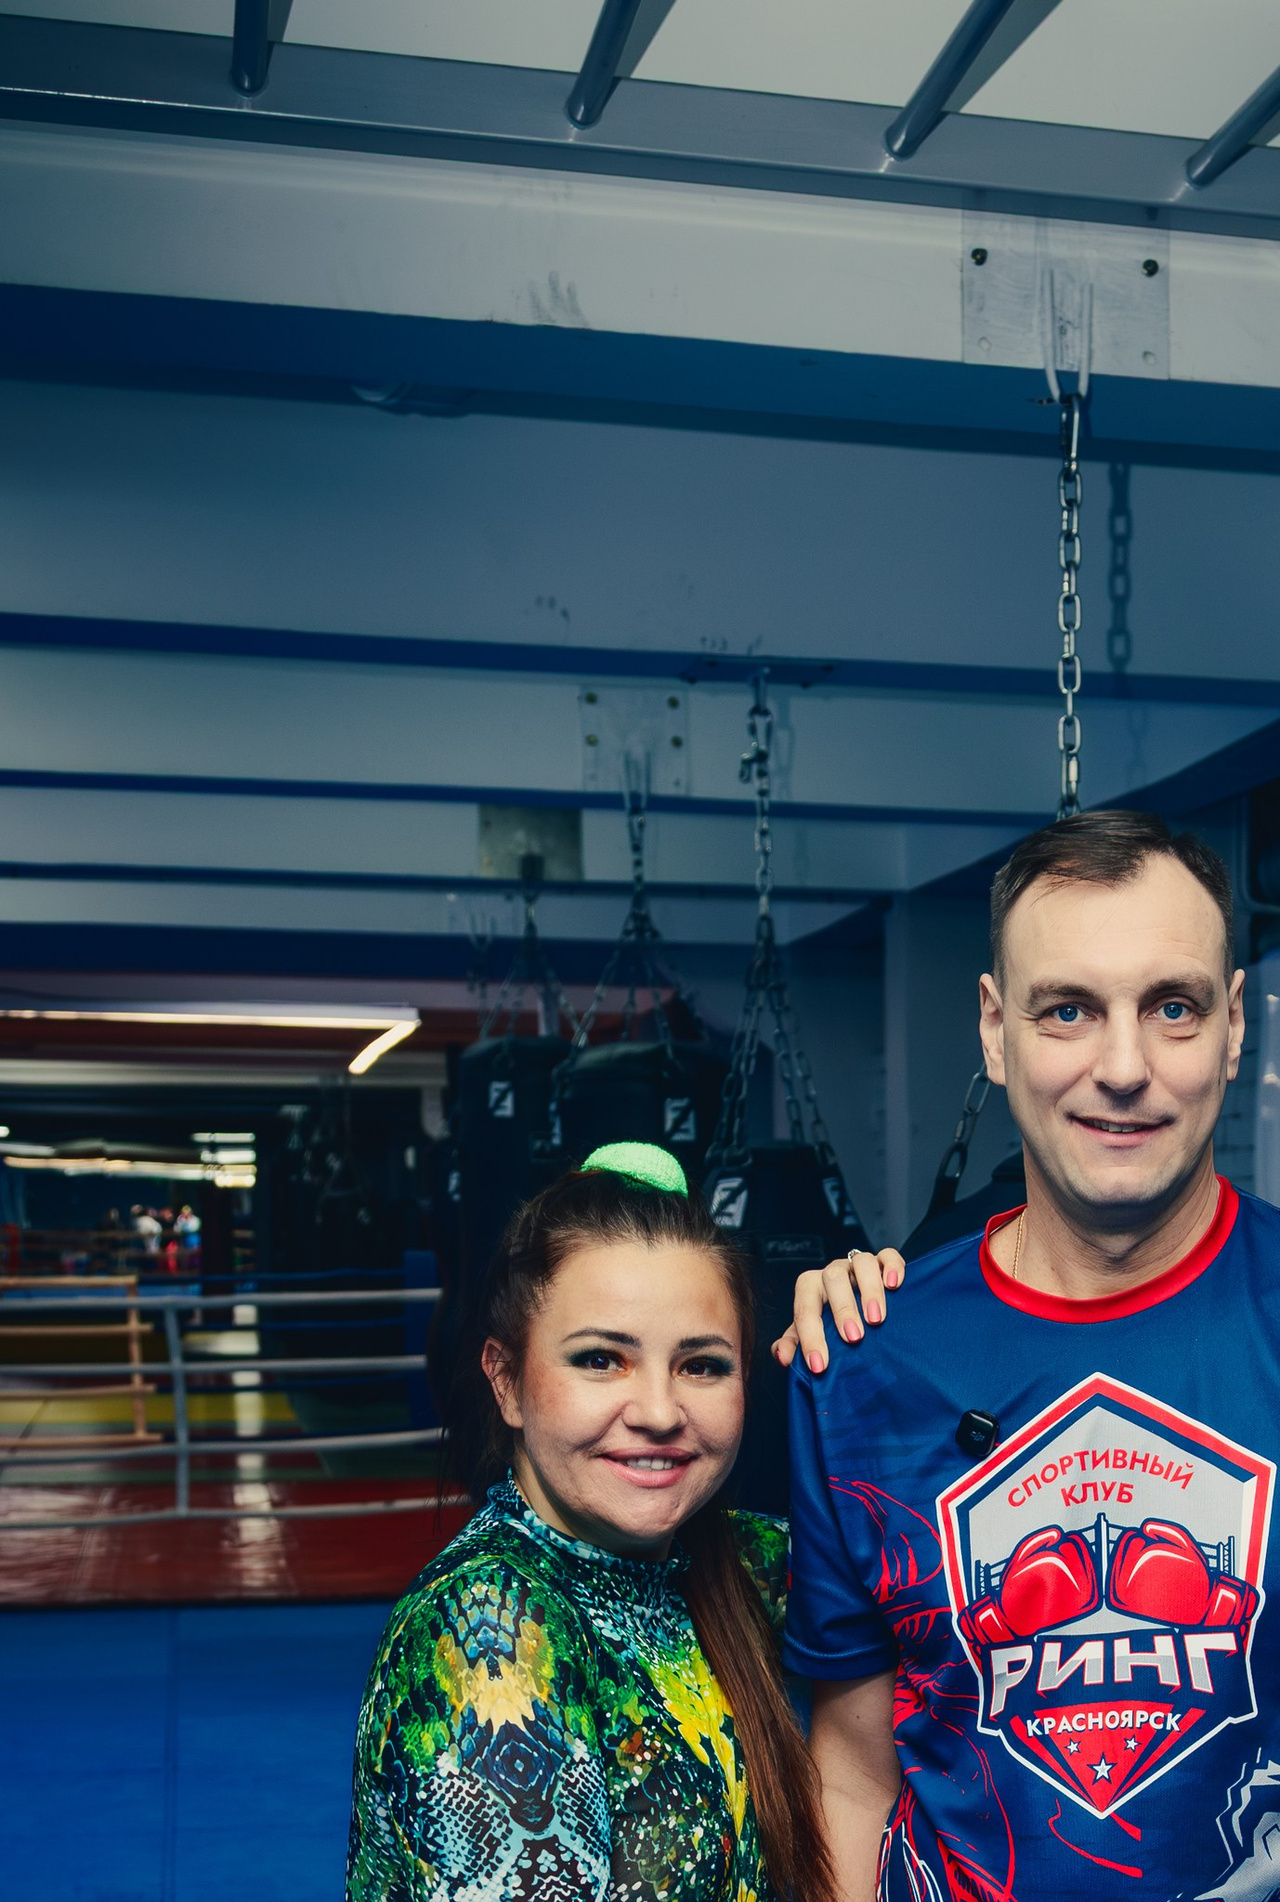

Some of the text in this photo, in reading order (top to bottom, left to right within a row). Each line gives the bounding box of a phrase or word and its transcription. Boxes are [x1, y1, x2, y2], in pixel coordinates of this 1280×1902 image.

[1007, 1448, 1195, 1508] СПОРТИВНЫЙ
[1060, 1481, 1133, 1507] КЛУБ
[989, 1632, 1239, 1720] РИНГ
[1026, 1709, 1182, 1738] КРАСНОЯРСК
